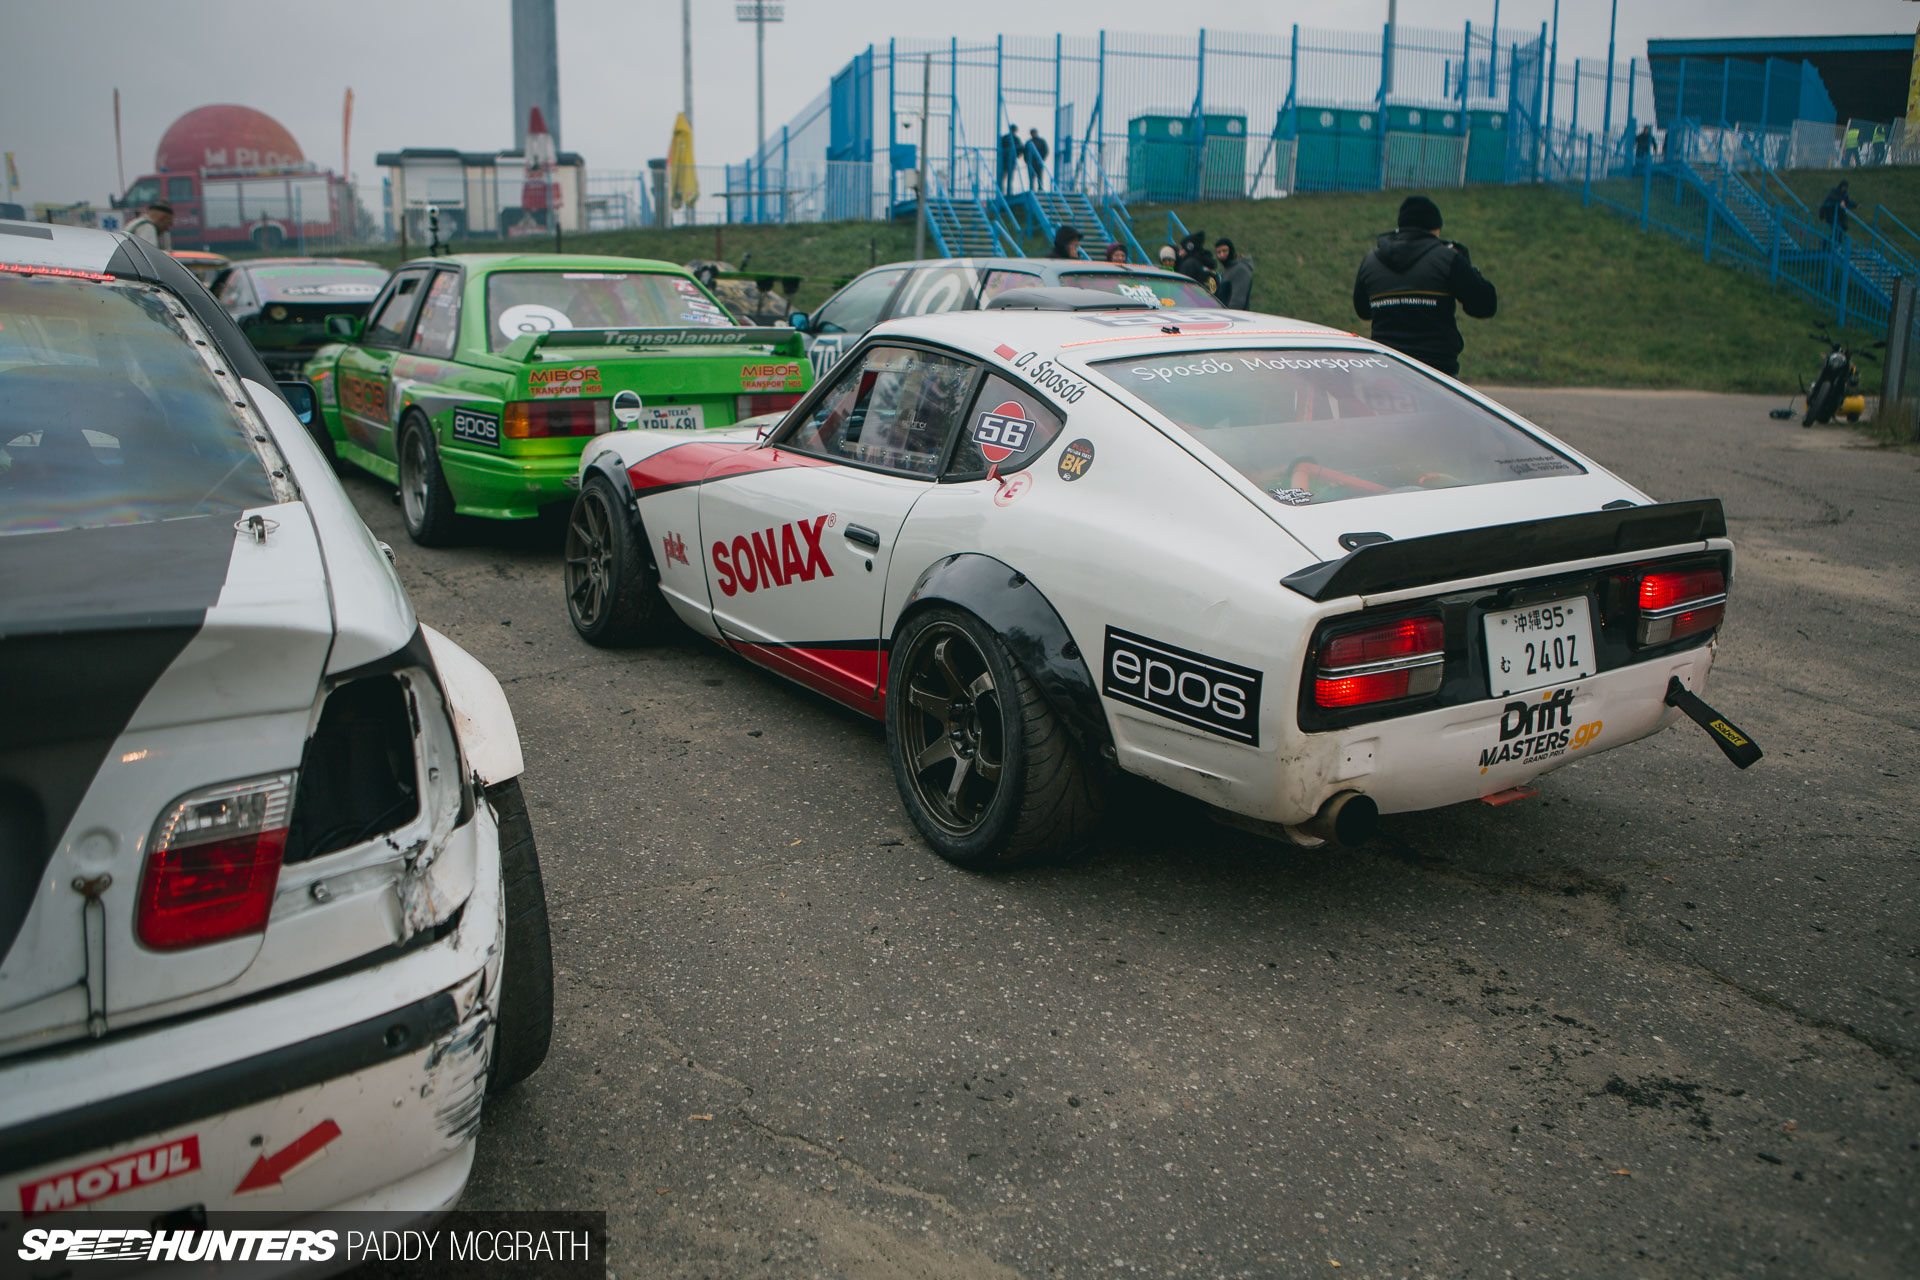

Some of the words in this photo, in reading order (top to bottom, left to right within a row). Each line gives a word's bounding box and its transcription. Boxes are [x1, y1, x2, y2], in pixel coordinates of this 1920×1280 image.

[1401, 298, 1422, 306] GRAND
[1422, 298, 1437, 306] PRIX
[604, 331, 747, 345] Transplanner
[529, 368, 602, 383] MIBOR
[741, 365, 801, 378] MIBOR
[1131, 358, 1234, 383] Sposób
[1240, 356, 1388, 373] Motorsport
[529, 386, 582, 395] TRANSPORT
[585, 384, 602, 393] HDS
[741, 380, 785, 388] TRANSPORT
[1030, 361, 1087, 404] Sposób
[668, 409, 688, 417] TEXAS
[455, 414, 497, 438] epos
[978, 416, 1028, 447] 56
[1060, 453, 1087, 475] BK
[1004, 481, 1024, 498] E
[712, 514, 834, 597] SONAX
[1525, 634, 1579, 676] 240Z
[1112, 649, 1246, 720] epos
[1499, 688, 1576, 742] Drift
[1523, 752, 1549, 765] GRAND
[1549, 749, 1565, 760] PRIX
[33, 1142, 192, 1213] MOTUL
